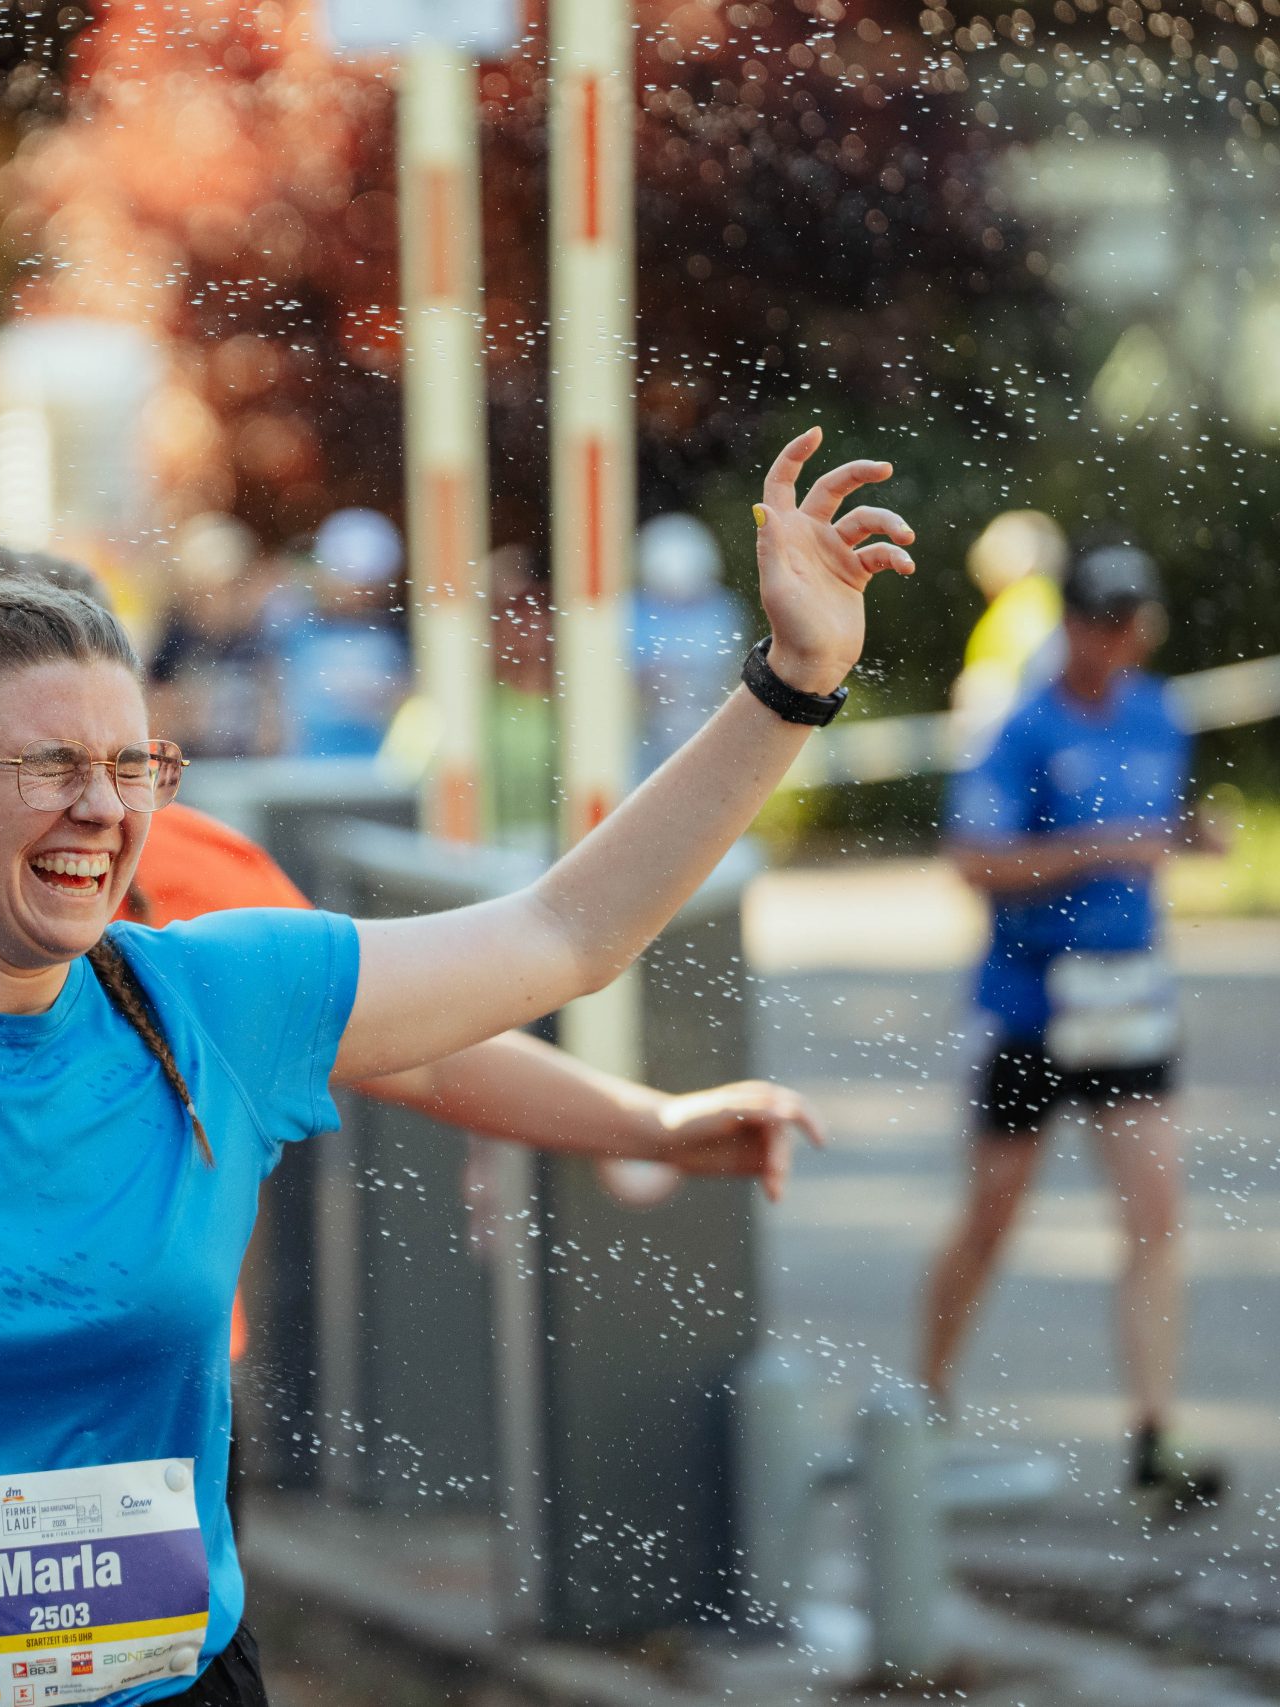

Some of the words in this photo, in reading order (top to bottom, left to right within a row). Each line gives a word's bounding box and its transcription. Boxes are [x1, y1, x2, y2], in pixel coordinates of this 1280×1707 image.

[5, 1487, 22, 1498] dm
[5, 1505, 37, 1517] FIRMEN
[7, 1516, 37, 1532] LAUF
[30, 1602, 90, 1631] 2503
[26, 1635, 60, 1648] STARTZEIT
[61, 1634, 77, 1644] 18:15
[78, 1632, 93, 1642] UHR
[29, 1665, 57, 1676] 88.3
